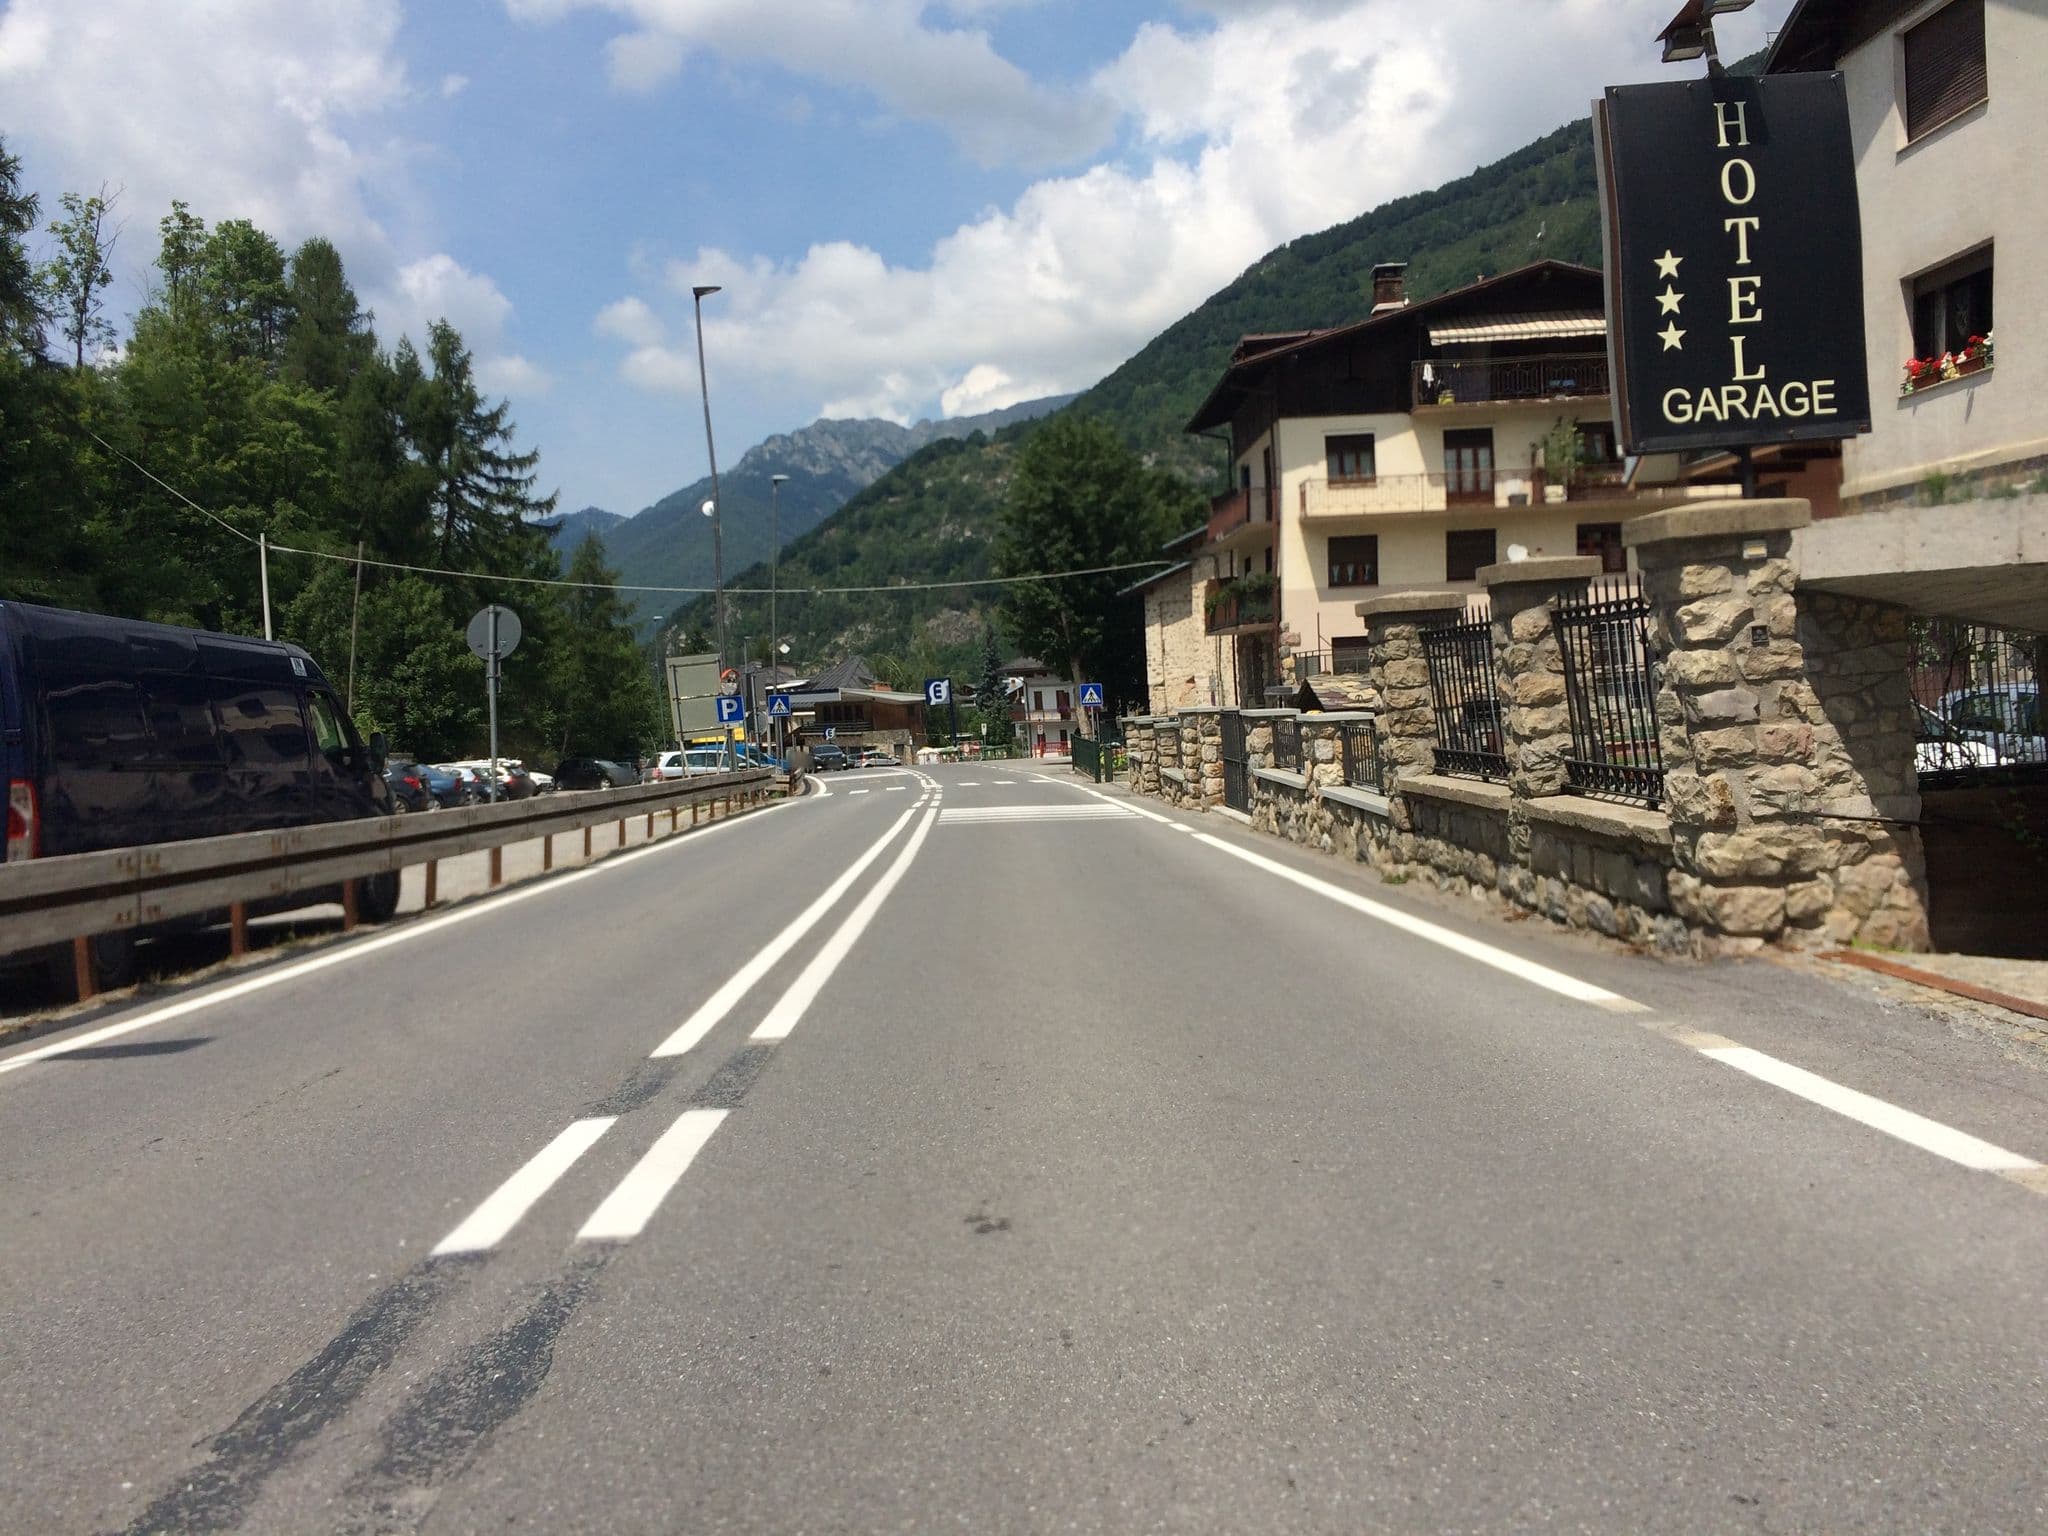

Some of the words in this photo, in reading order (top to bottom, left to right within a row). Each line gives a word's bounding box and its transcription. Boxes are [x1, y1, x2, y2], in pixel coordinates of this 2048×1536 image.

[1713, 101, 1766, 381] HOTEL
[1662, 379, 1838, 423] GARAGE
[721, 699, 738, 720] P
